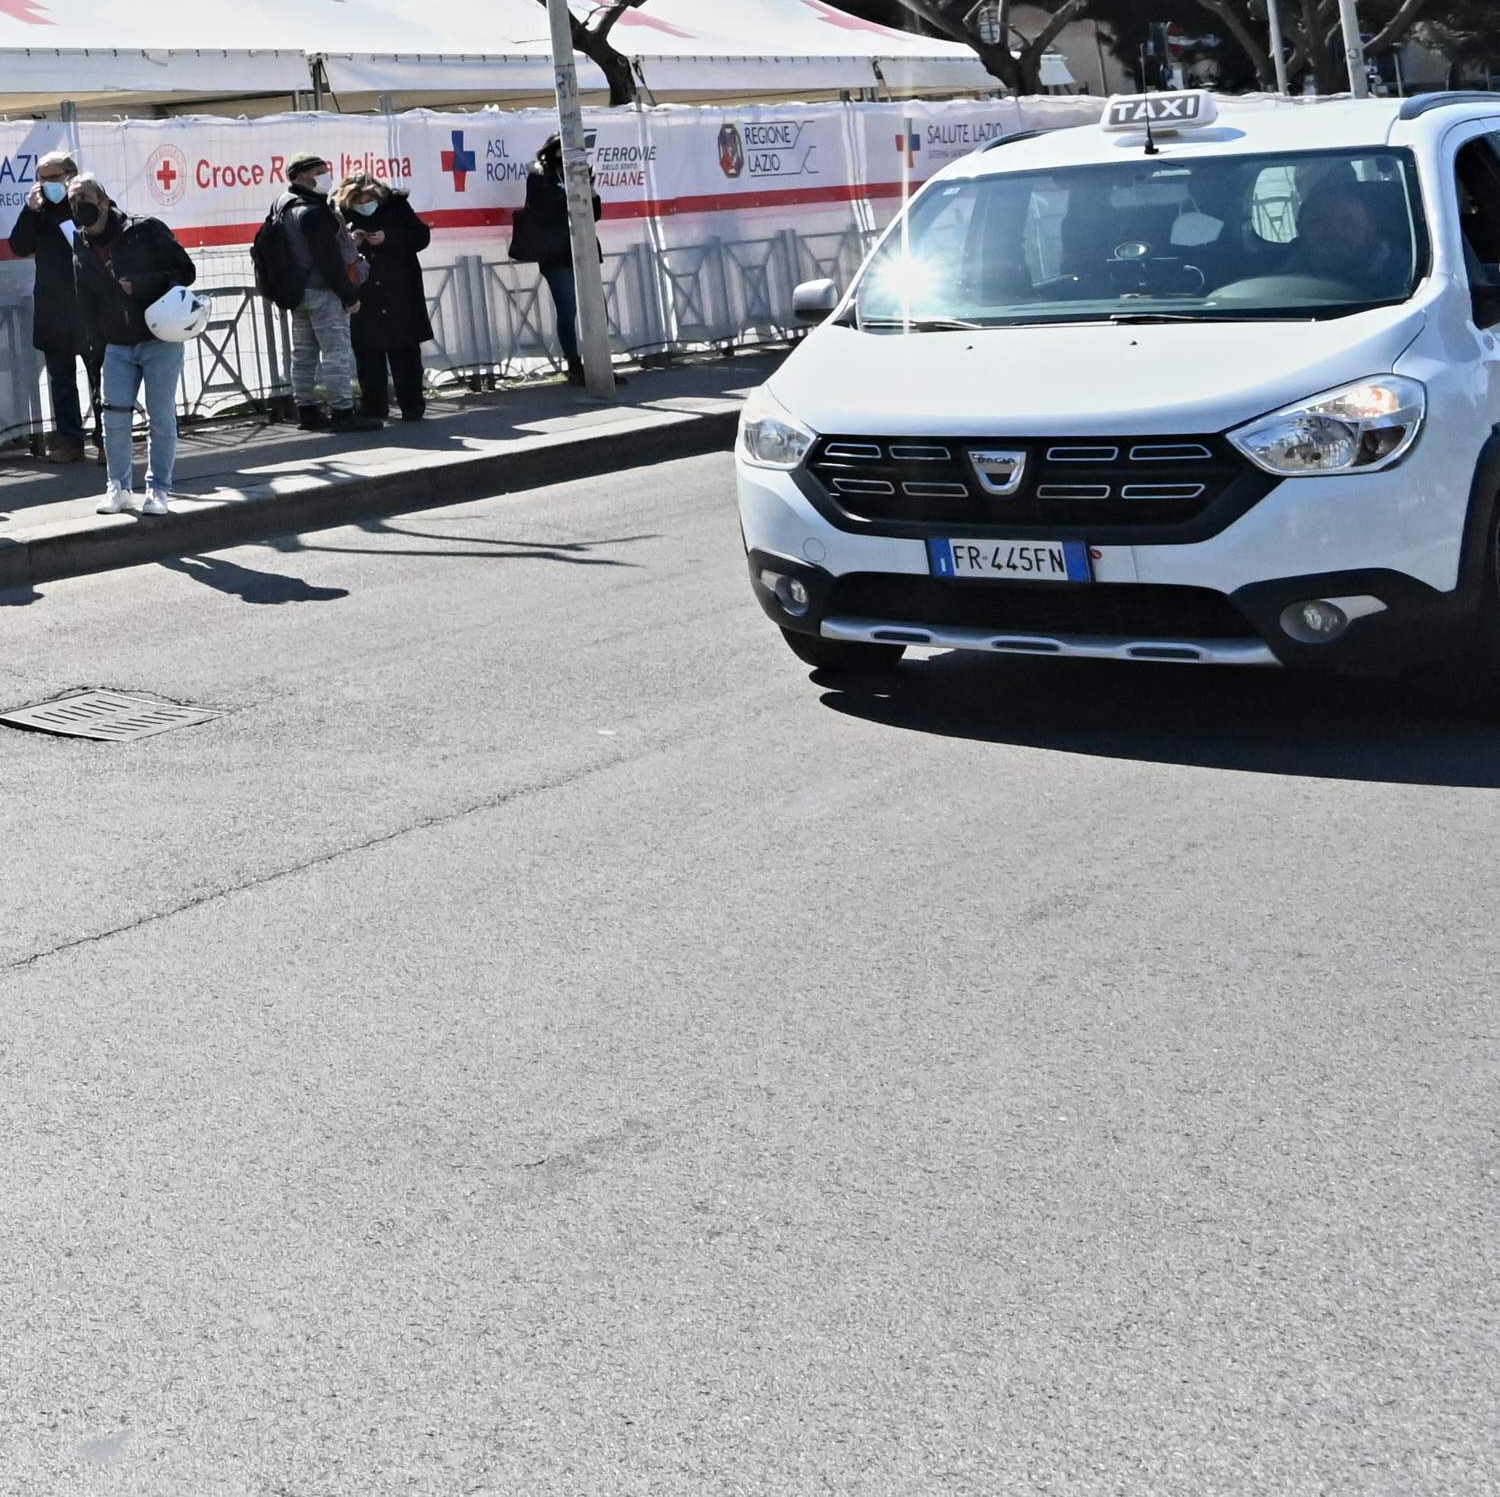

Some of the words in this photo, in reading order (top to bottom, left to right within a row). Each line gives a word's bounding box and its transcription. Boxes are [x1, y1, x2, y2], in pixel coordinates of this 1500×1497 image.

[1112, 97, 1196, 121] TAXI
[745, 126, 791, 145] REGIONE
[927, 124, 969, 144] SALUTE
[487, 139, 509, 158] ASL
[596, 146, 657, 162] FERROVIE
[486, 162, 527, 181] ROMA
[748, 154, 780, 173] LAZIO
[196, 159, 264, 188] Croce
[597, 171, 645, 187] TALIANE
